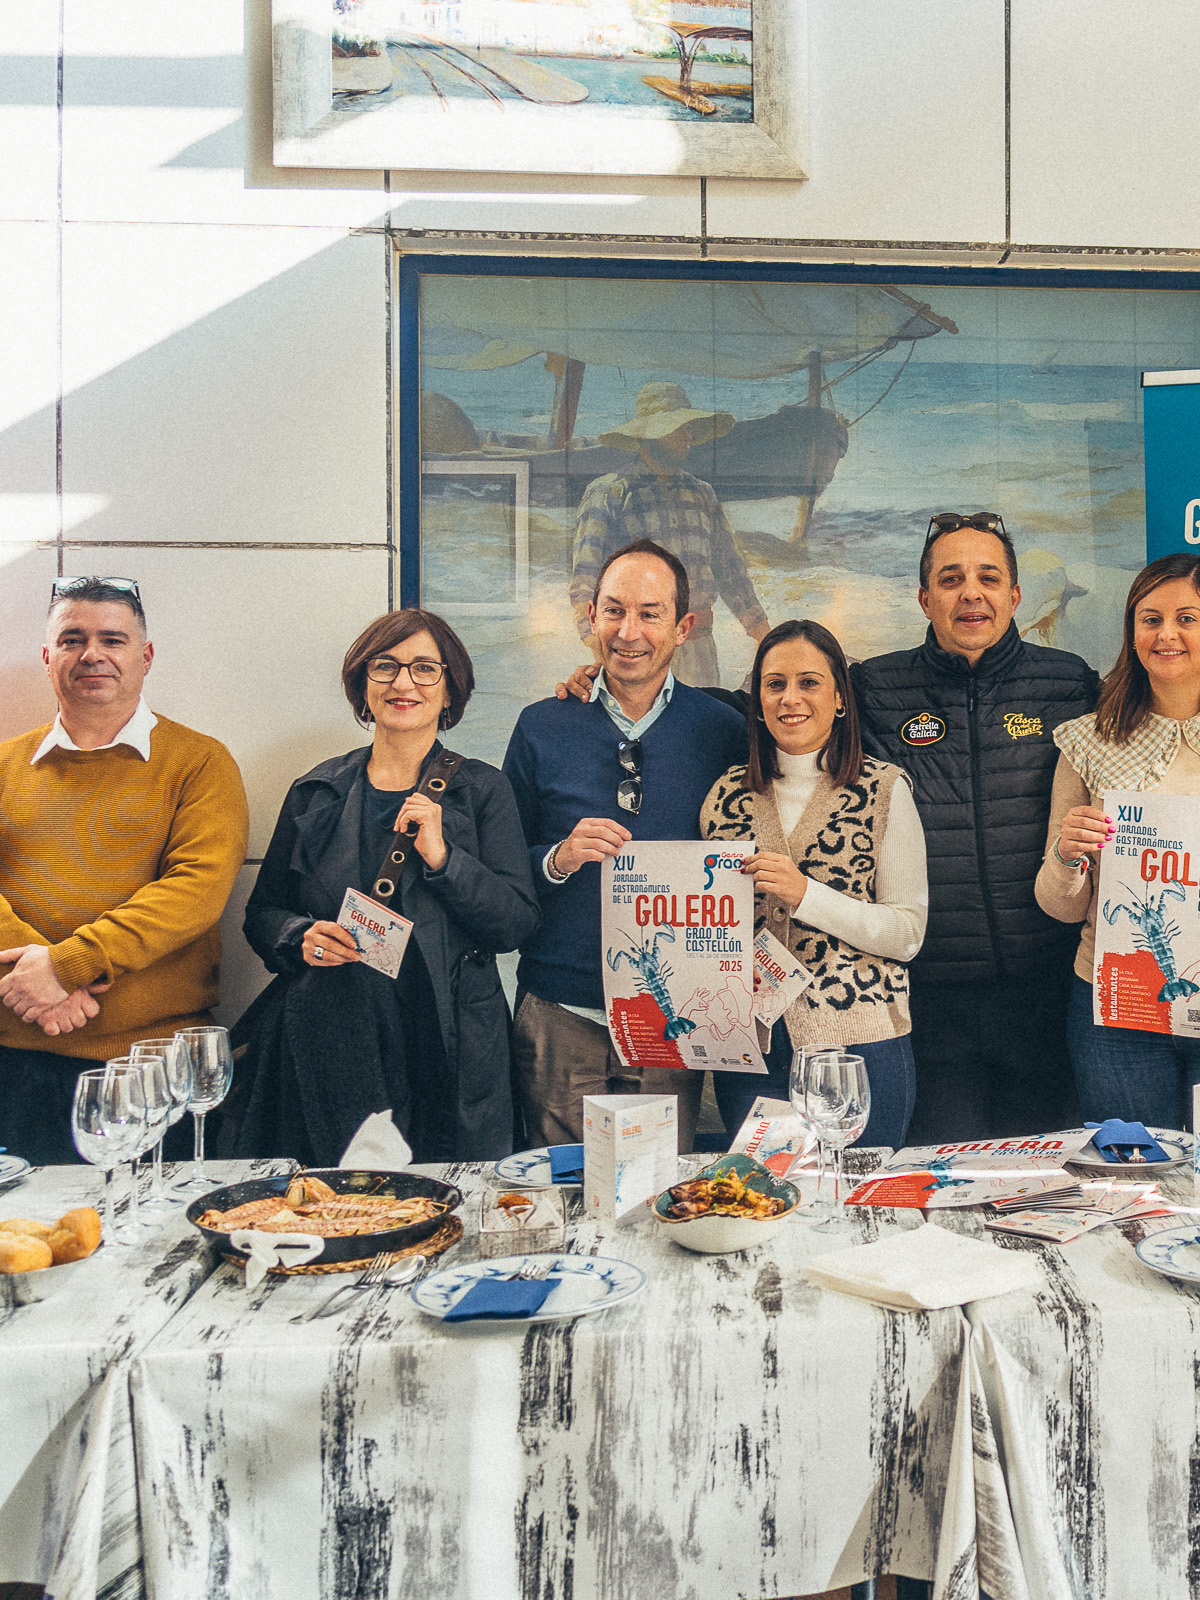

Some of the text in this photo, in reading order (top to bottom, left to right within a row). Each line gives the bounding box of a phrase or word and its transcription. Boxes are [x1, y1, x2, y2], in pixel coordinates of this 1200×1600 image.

[909, 721, 939, 732] Estrella
[909, 730, 938, 739] Galicia
[1118, 804, 1143, 822] XIV
[1117, 825, 1158, 836] JORNADAS
[1116, 836, 1183, 850] GASTRONÓMICAS
[1116, 847, 1138, 856] DE LA
[612, 855, 634, 871] XIV
[612, 874, 648, 882] JORNADAS
[612, 884, 670, 893] GASTRONÓMICAS
[612, 896, 632, 904] DE LA
[635, 894, 740, 928] GALERA
[686, 928, 728, 940] GRAO DE
[685, 938, 742, 952] CASTELLÓN
[719, 960, 742, 972] 2025
[1108, 967, 1118, 1020] Restaurantes
[620, 1010, 640, 1060] Restaurantes
